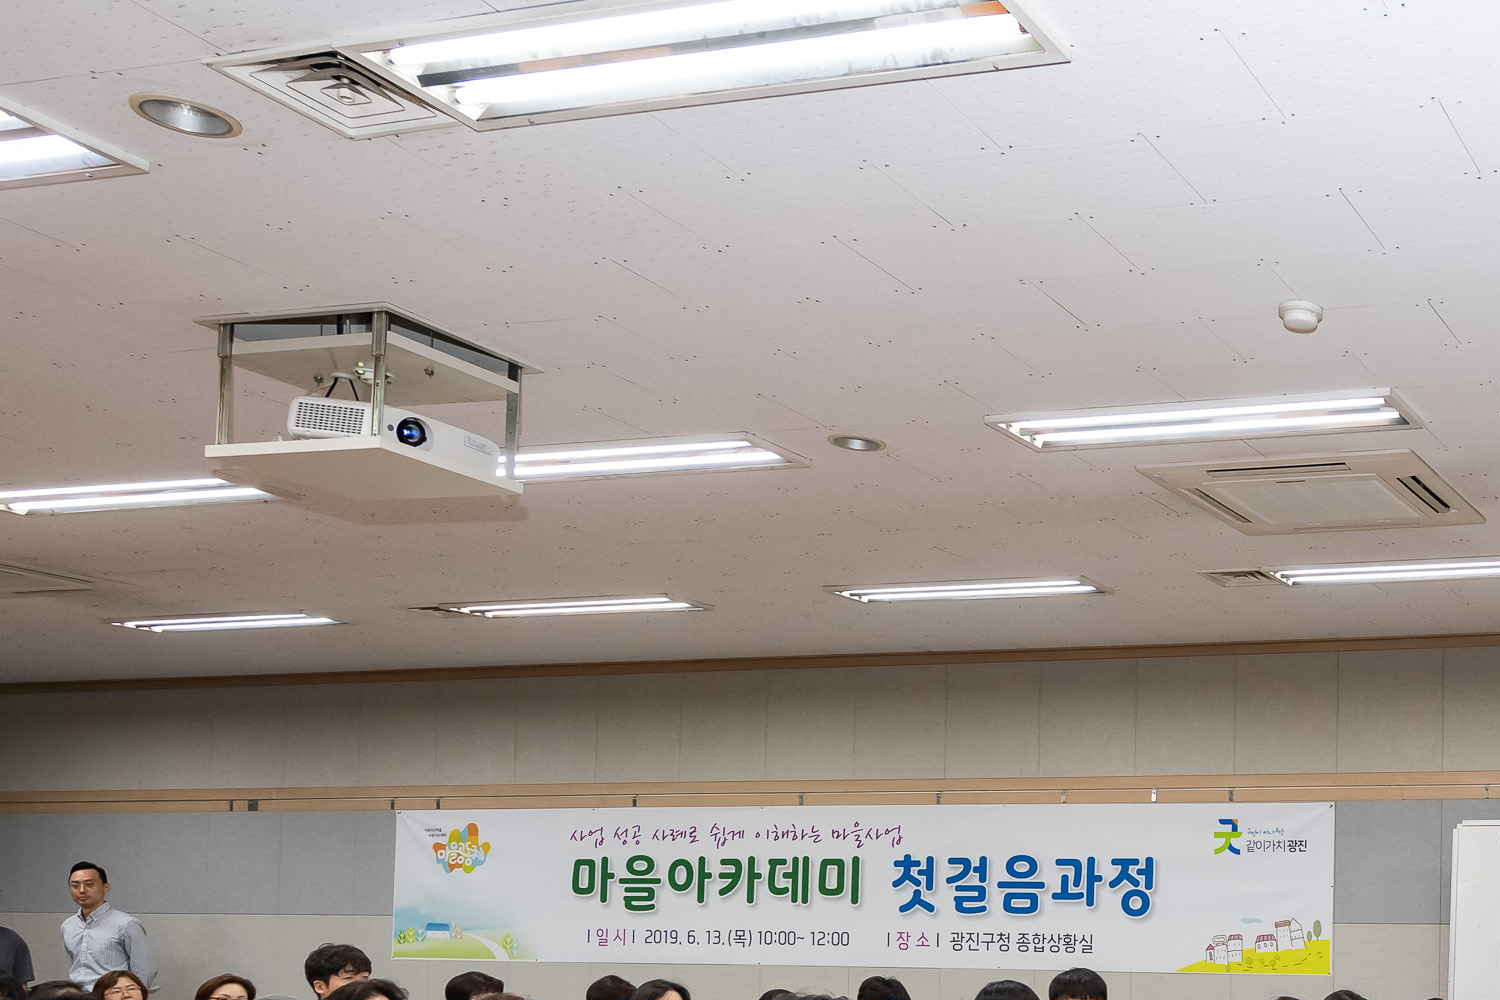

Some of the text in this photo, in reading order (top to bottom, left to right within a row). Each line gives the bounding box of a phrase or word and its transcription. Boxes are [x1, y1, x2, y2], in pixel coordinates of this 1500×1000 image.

[570, 821, 903, 849] 사업 성공 사례로 쉽게 이해하는 마을사업
[571, 854, 1157, 917] 마을아카데미 첫걸음과정
[645, 930, 681, 945] 2019.
[811, 931, 849, 946] 12:00
[950, 932, 1010, 952] 광진구청
[1016, 933, 1093, 953] 종합상황실
